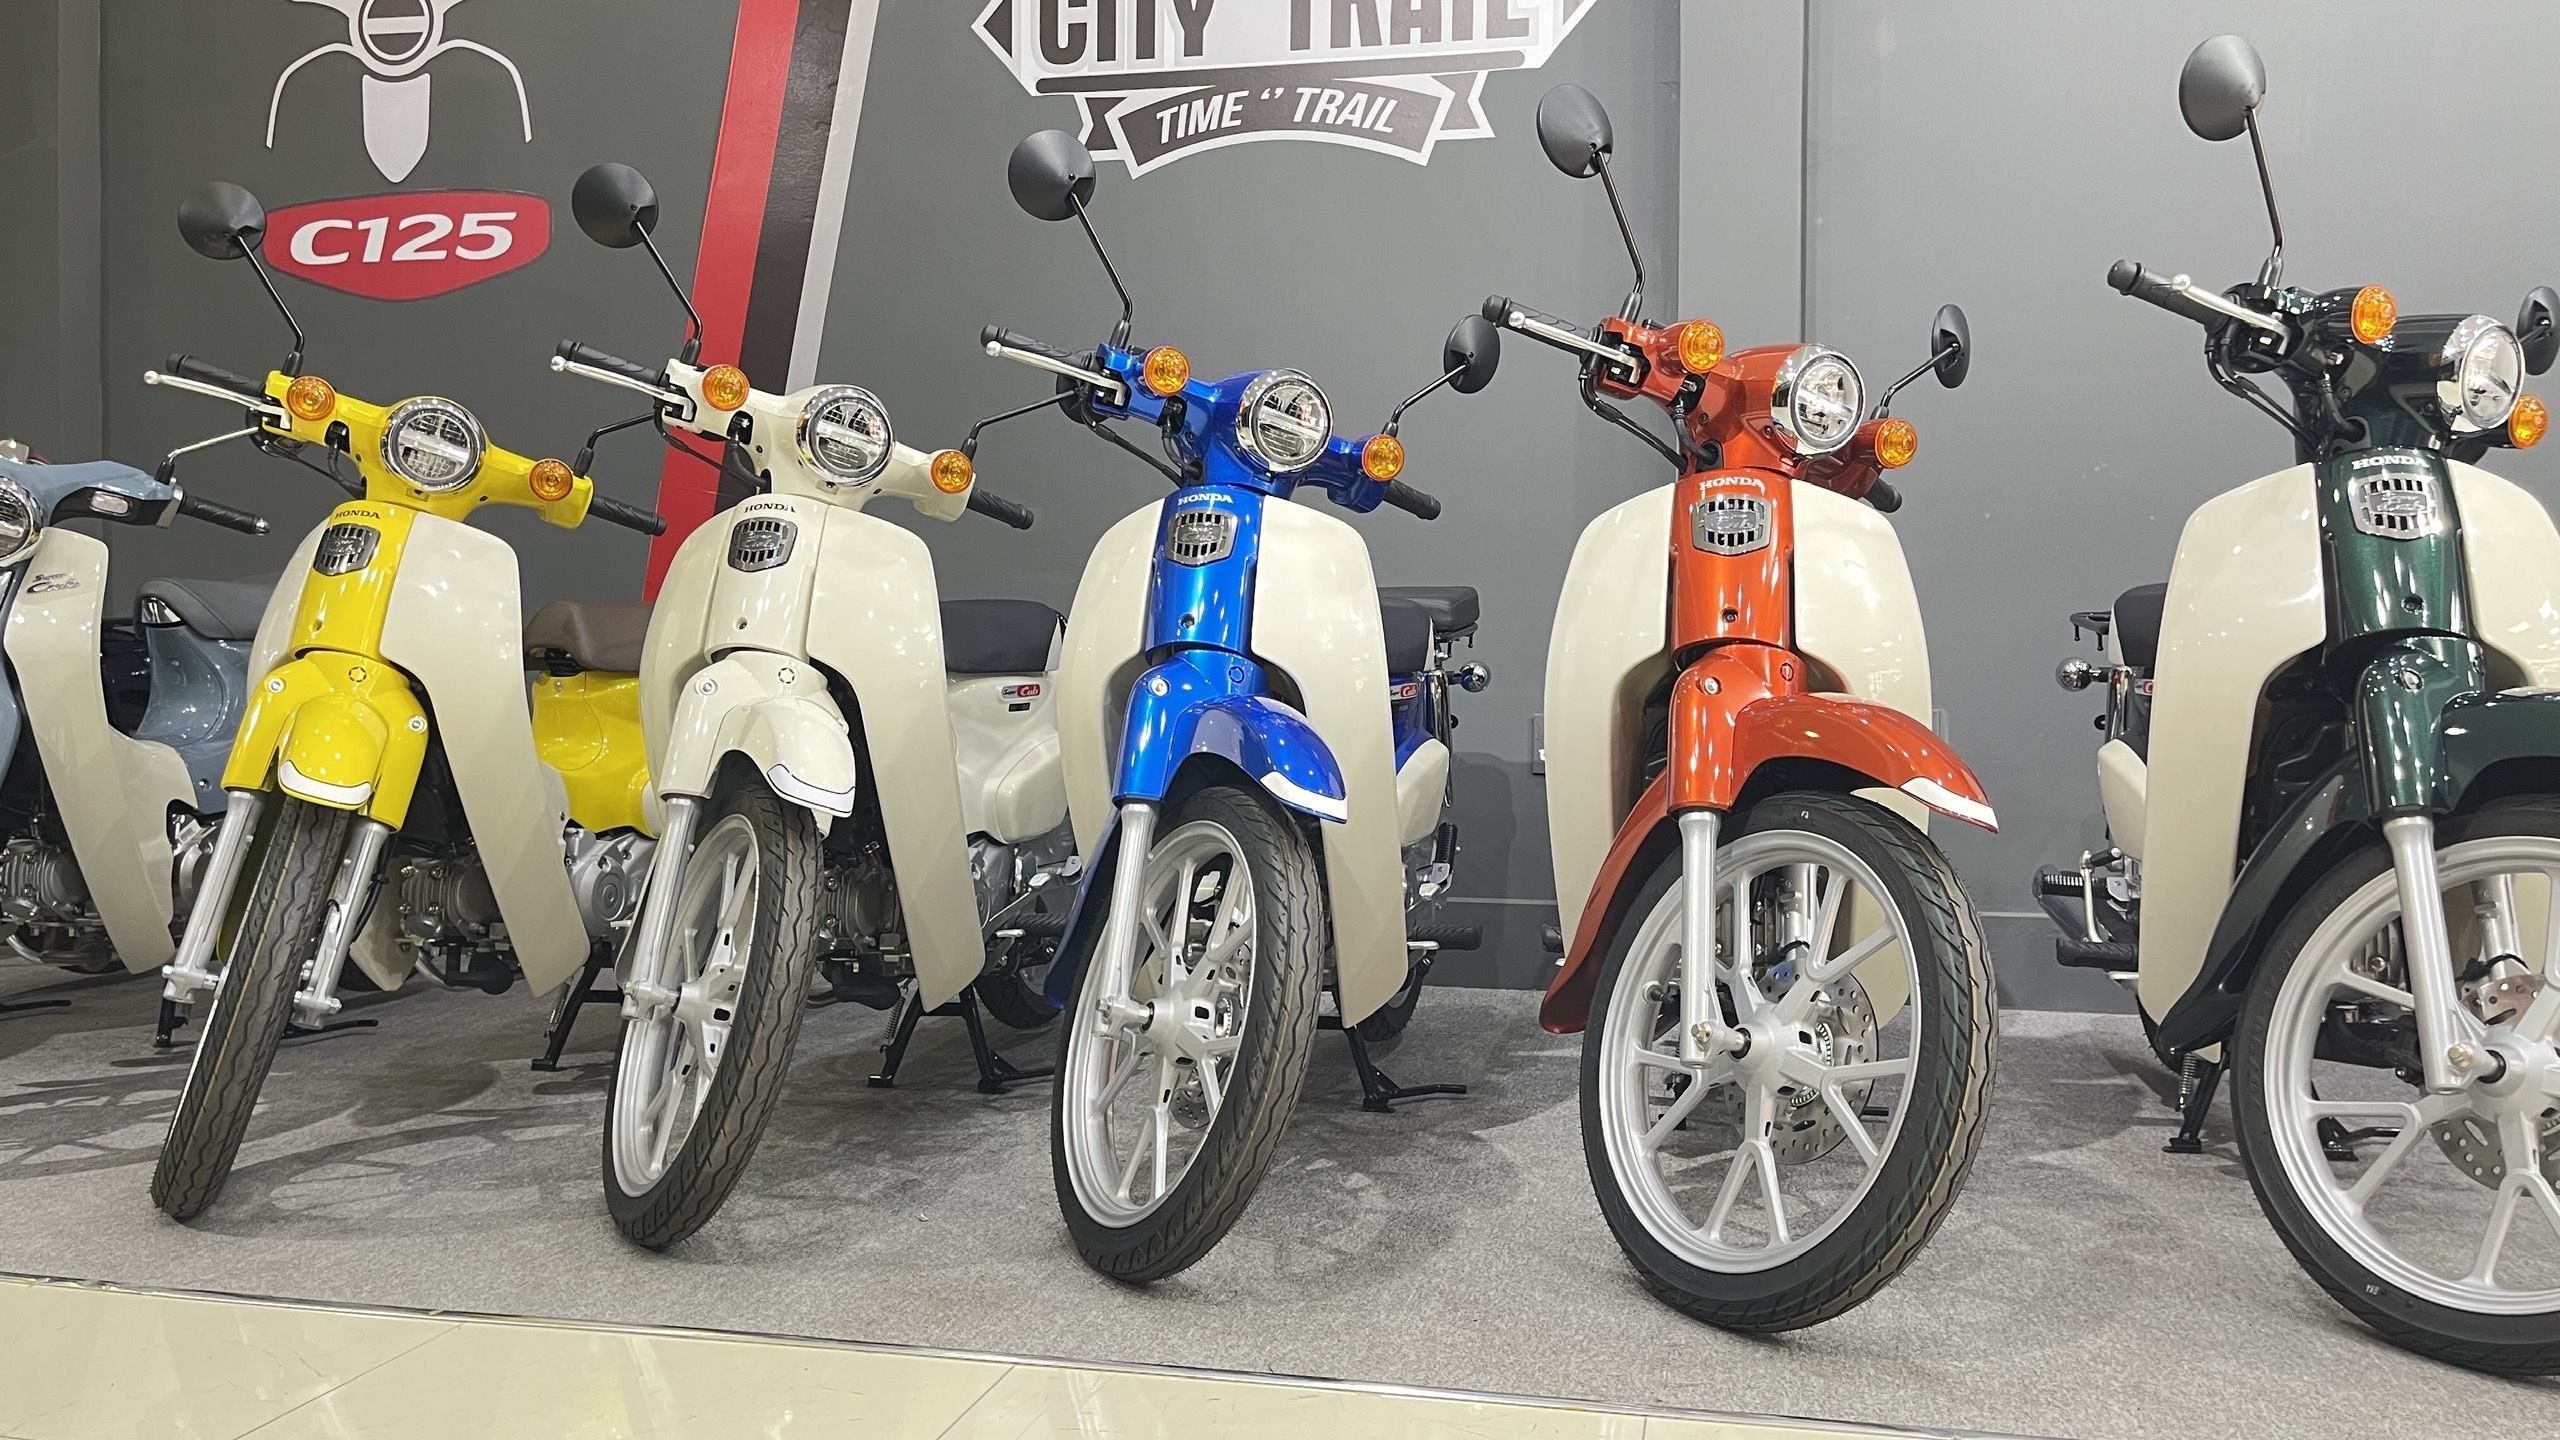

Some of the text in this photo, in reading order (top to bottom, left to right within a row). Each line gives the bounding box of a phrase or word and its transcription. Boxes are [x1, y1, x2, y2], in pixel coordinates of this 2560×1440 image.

[1156, 90, 1249, 144] TIME
[1293, 87, 1399, 134] TRAIL
[290, 211, 517, 265] C125
[2351, 455, 2431, 470] HONDA
[1699, 476, 1765, 491] HONDA
[1177, 493, 1234, 506] HONDA
[334, 509, 381, 519] HONDA
[744, 503, 796, 514] HONDA
[1020, 685, 1039, 696] Cub
